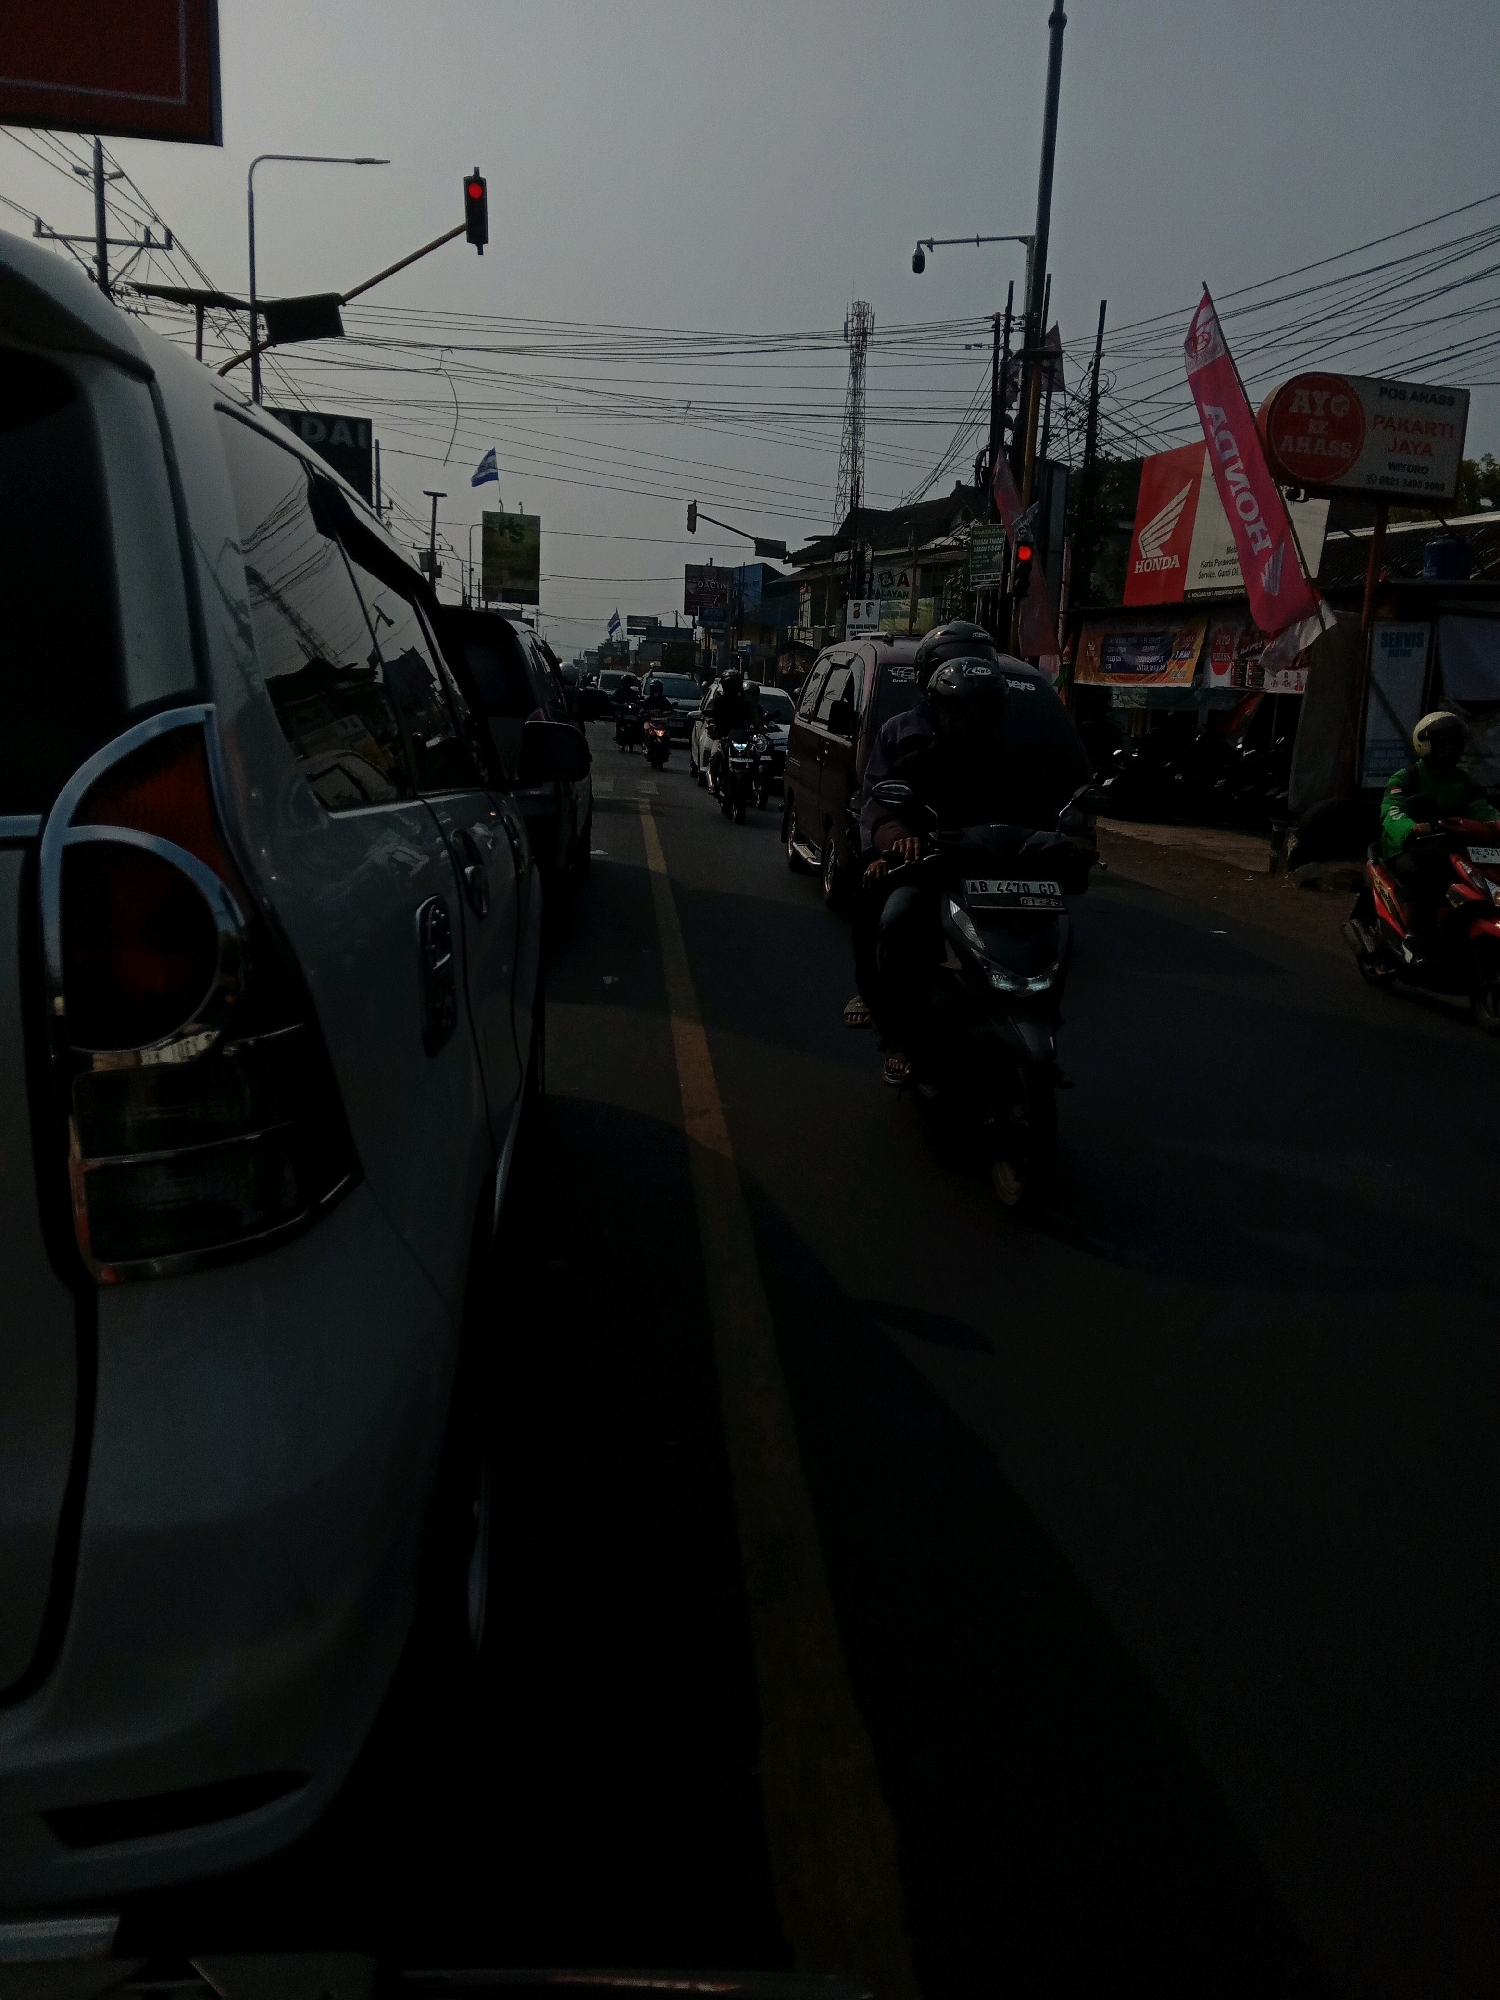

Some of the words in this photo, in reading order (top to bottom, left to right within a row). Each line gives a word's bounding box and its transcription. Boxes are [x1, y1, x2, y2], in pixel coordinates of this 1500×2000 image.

[1288, 389, 1350, 417] AYO
[1379, 386, 1407, 401] POS
[1372, 414, 1454, 439] PAKARTI
[1280, 435, 1353, 458] AHASS
[1388, 438, 1433, 457] JAYA
[1133, 554, 1180, 574] HONDA
[1380, 631, 1425, 648] SERVIS
[970, 881, 988, 892] AB
[997, 882, 1030, 893] 4470
[1039, 883, 1056, 894] GD
